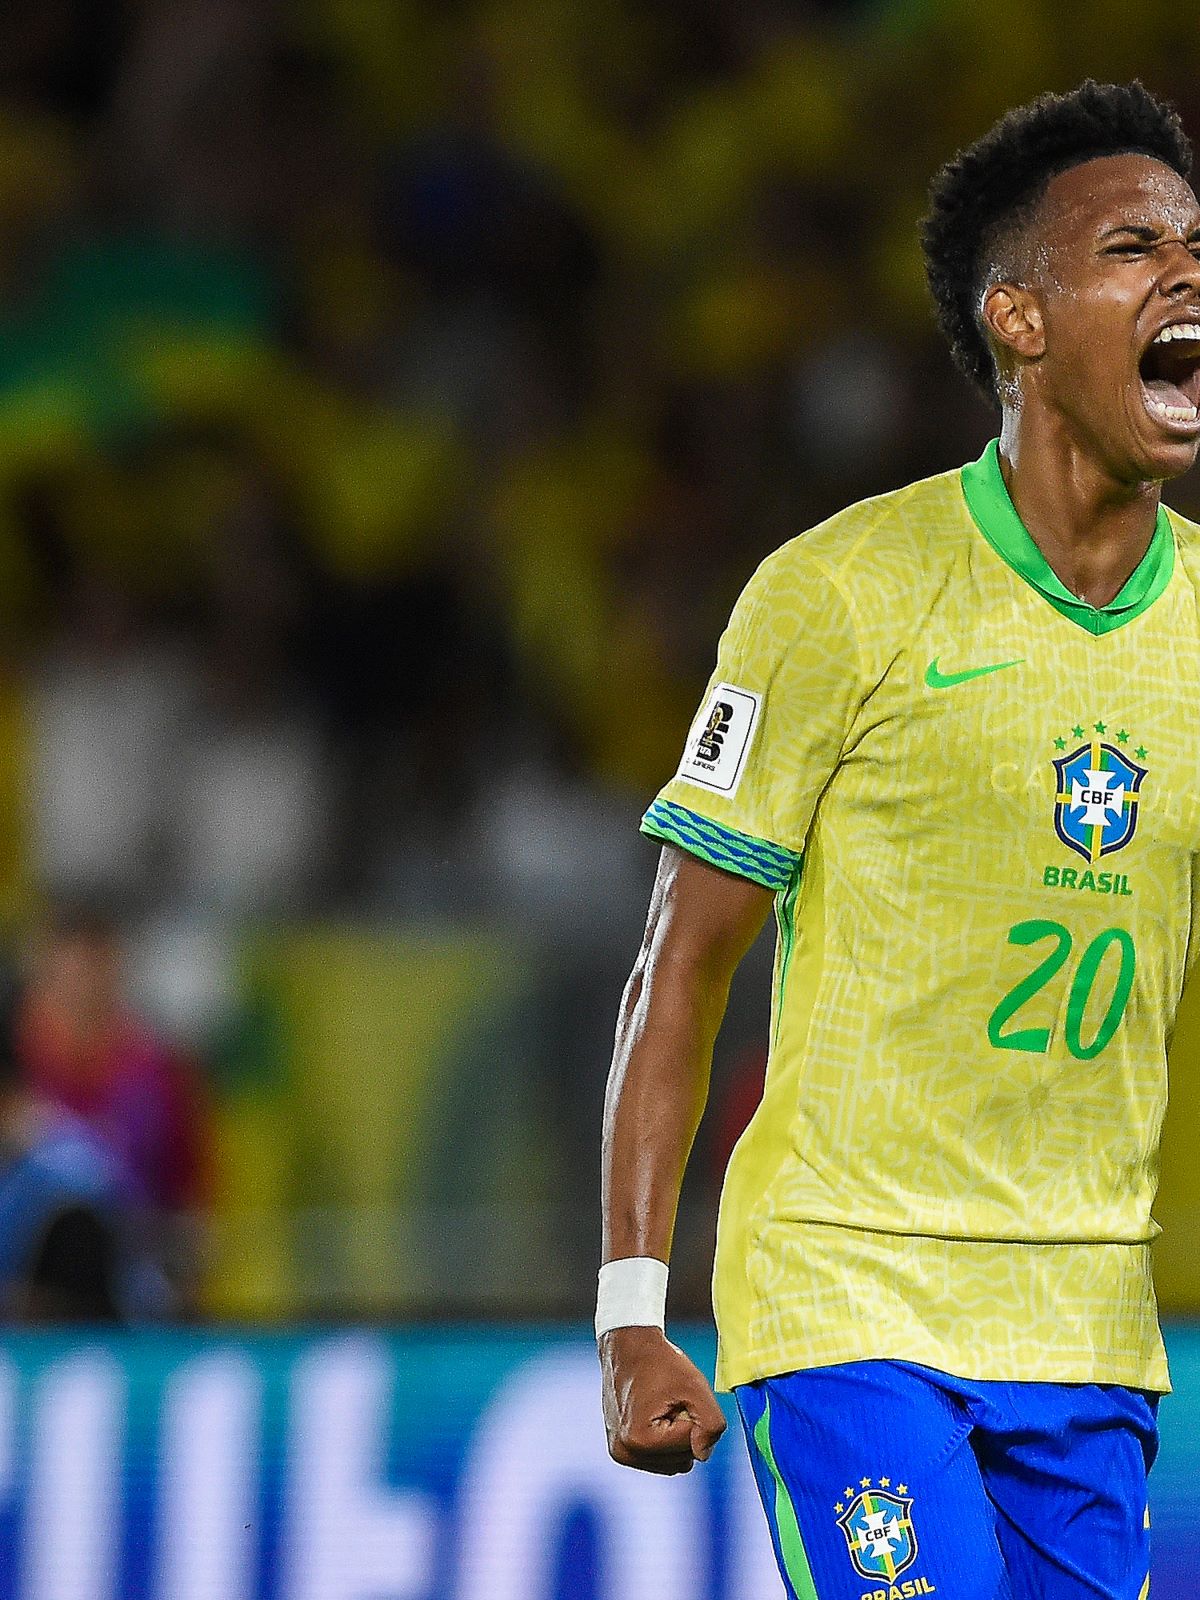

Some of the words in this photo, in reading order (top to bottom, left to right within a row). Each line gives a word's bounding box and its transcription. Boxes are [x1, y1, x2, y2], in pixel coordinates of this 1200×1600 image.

[1080, 790, 1115, 806] CBF
[1042, 865, 1134, 896] BRASIL
[987, 919, 1136, 1060] 20
[865, 1526, 891, 1541] CBF
